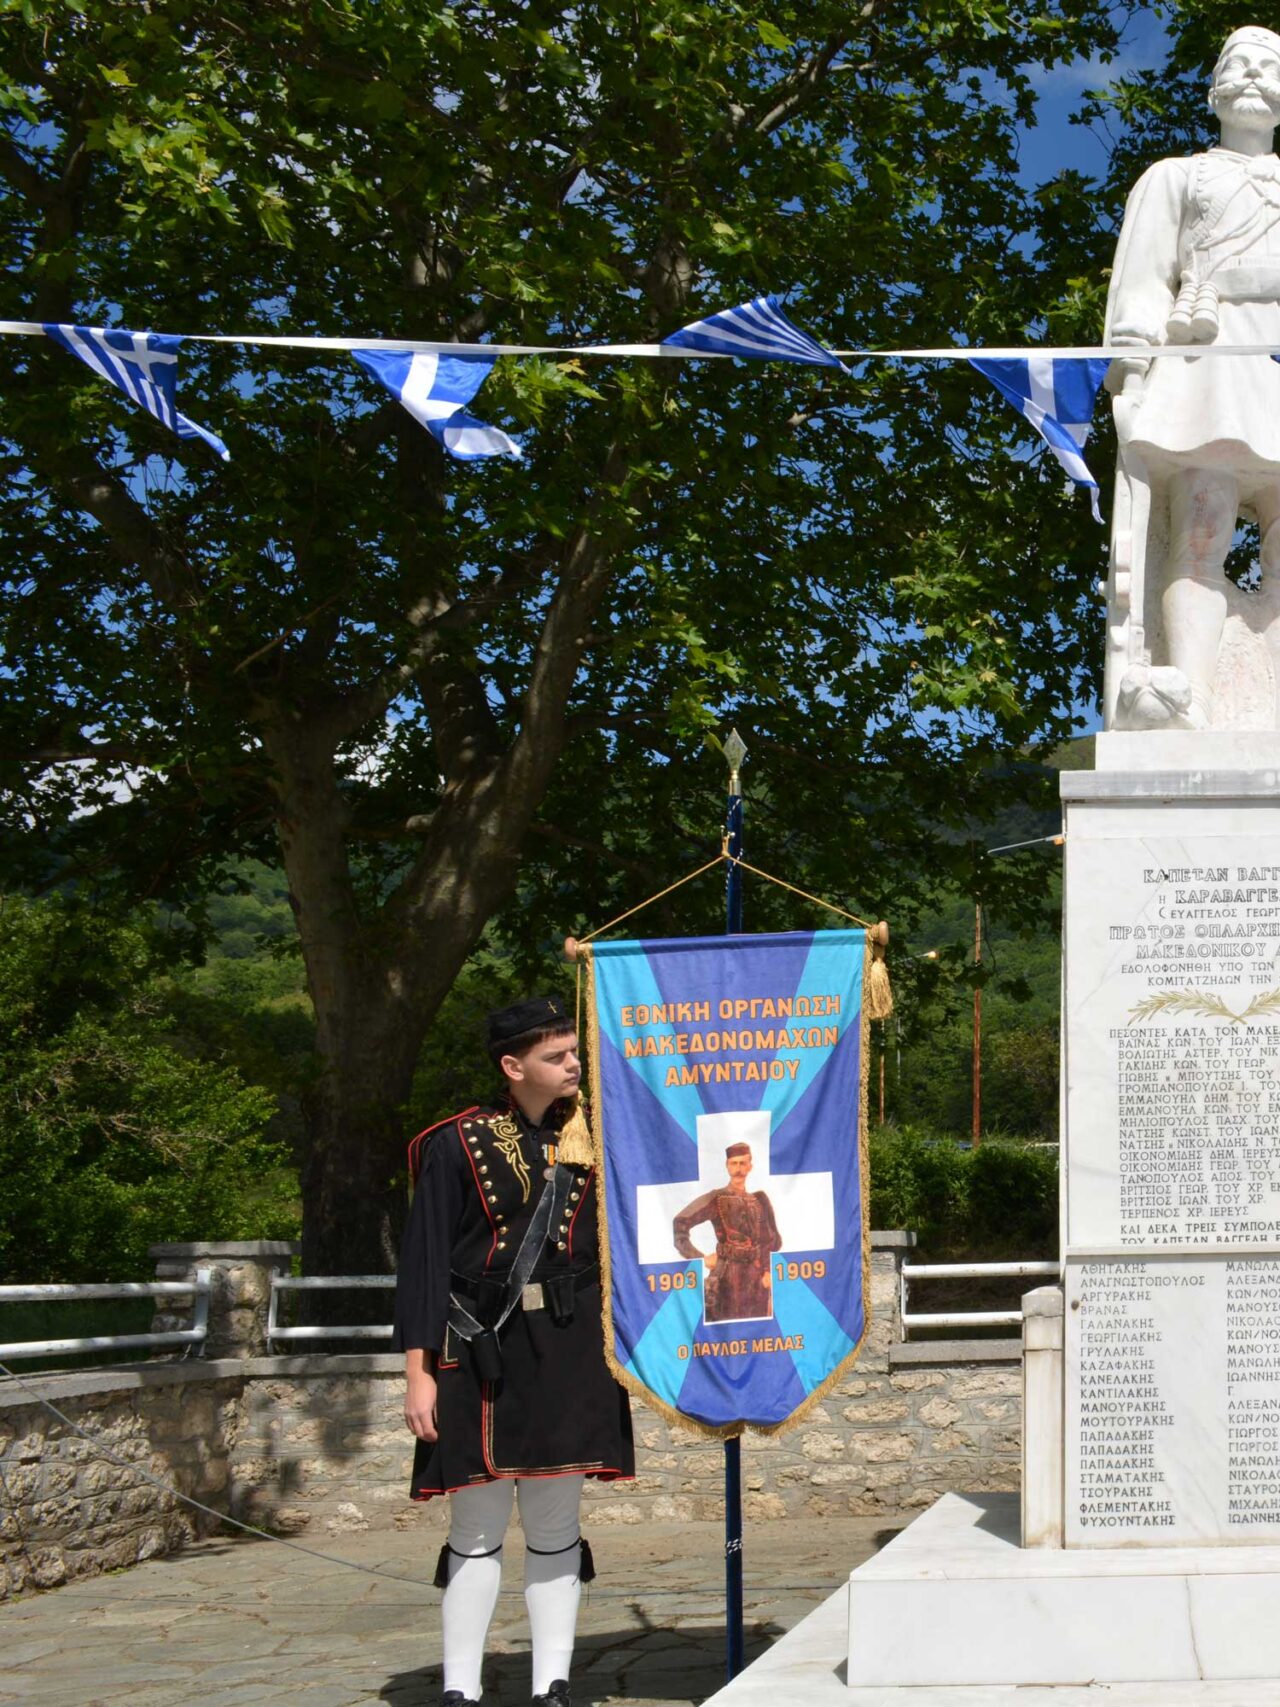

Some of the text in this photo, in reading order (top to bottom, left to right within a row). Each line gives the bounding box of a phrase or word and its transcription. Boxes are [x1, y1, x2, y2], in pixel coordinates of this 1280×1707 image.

[1143, 868, 1229, 883] ΚΑΠΕΤΑΝ
[1109, 925, 1185, 940] ΠΡΩΤΟΣ
[1136, 942, 1266, 959] ΜΑΚΕΔΟΝΙΚΟΥ
[1121, 962, 1211, 974] ΕΔΟΛΟΦΟΝΗΘΗ
[1219, 962, 1244, 972] ΥΠΟ
[1251, 961, 1275, 971] ΤΩΝ
[1147, 975, 1241, 986] ΚΟΜΙΤΑΤΖΗΔΩΝ
[1249, 974, 1272, 984] ΤΗΝ
[620, 995, 841, 1027] ΕΘΝΙΚΗ ΟΡΓΑΝΩΣΗ
[1109, 1028, 1167, 1038] ΠΕΣΟΝΤΕΣ
[1175, 1027, 1206, 1037] ΚΑΤΑ
[1214, 1026, 1239, 1036] ΤΟΝ
[624, 1026, 840, 1058] ΜΑΚΕΔΟΝΟΜΑΧΩΝ
[1199, 1037, 1223, 1047] ΤΟΥ
[1267, 1036, 1280, 1045] ΕΞ
[1228, 1048, 1252, 1057] ΤΟΥ
[1118, 1061, 1167, 1071] ΓΑΚΙΔΗΣ
[1205, 1059, 1229, 1069] ΤΟΥ
[665, 1059, 800, 1087] ΑΜΥΝΤΑΙΟΥ
[1178, 1070, 1242, 1081] ΜΠΟΥΤΣΗΣ
[1249, 1070, 1274, 1079] ΤΟΥ
[1118, 1094, 1196, 1105] ΕΜΜΑΝΟΥΗΛ
[1236, 1093, 1261, 1102] ΤΟΥ
[1118, 1105, 1197, 1116] ΕΜΜΑΝΟΥΗΛ
[1236, 1104, 1260, 1113] ΤΟΥ
[1119, 1117, 1209, 1127] ΜΗΛΙΟΠΟΥΛΟΣ
[1255, 1115, 1279, 1124] ΤΟΥ
[1119, 1128, 1165, 1139] ΝΑΤΣΗΣ
[1218, 1127, 1242, 1136] ΤΟΥ
[1119, 1140, 1165, 1150] ΝΑΤΣΗΣ
[1177, 1138, 1248, 1148] ΝΙΚΟΛΑΙΔΗΣ
[1119, 1151, 1203, 1161] ΟΙΚΟΝΟΜΙΔΗΣ
[1242, 1148, 1280, 1159] ΙΕΡΕΥΣ
[1119, 1162, 1203, 1172] ΟΙΚΟΝΟΜΙΔΗΣ
[1246, 1160, 1271, 1169] ΤΟΥ
[1250, 1171, 1275, 1180] ΤΟΥ
[1215, 1183, 1240, 1193] ΤΟΥ
[1216, 1194, 1240, 1204] ΤΟΥ
[1120, 1208, 1180, 1219] ΤΕΡΠΕΝΟΣ
[1210, 1206, 1249, 1217] ΙΕΡΕΥΣ
[1120, 1224, 1140, 1234] ΚΑΙ
[1148, 1224, 1177, 1234] ΔΕΚΑ
[1185, 1223, 1217, 1233] ΤΡΕΙΣ
[775, 1261, 826, 1280] 1909
[1080, 1264, 1147, 1274] ΑΘΗΤΑΚΗΣ
[647, 1272, 697, 1292] 1903
[1080, 1276, 1205, 1288] ΑΝΑΓΝΩΣΤΟΠΟΥΛΟΣ
[1080, 1291, 1152, 1302] ΑΡΓΥΡΑΚΗΣ
[1080, 1305, 1127, 1316] ΒΡΑΝΑΣ
[1080, 1318, 1154, 1329] ΓΑΛΑΝΑΚΗΣ
[1080, 1332, 1162, 1343] ΓΕΩΡΓΙΛΑΚΗΣ
[677, 1335, 804, 1359] Ο ΠΑΥΛΟΣ ΜΕΛΑΣ
[1080, 1346, 1145, 1357] ΓΡΥΛΑΚΗΣ
[1080, 1360, 1155, 1371] ΚΑΖΑΦΑΚΗΣ
[1080, 1371, 1280, 1385] ΚΑΝΕΛΑΚΗΣ ΙΩΑΝΝΗΣ
[1080, 1388, 1159, 1399] ΚΑΝΤΙΛΑΚΗΣ
[1080, 1401, 1166, 1412] ΜΑΝΟΥΡΑΚΗΣ
[1080, 1416, 1174, 1427] ΜΟΥΤΟΥΡΑΚΗΣ
[1080, 1427, 1279, 1441] ΠΑΠΑΔΑΚΗΣ ΓΙΩΡΓΟΣ
[1080, 1441, 1279, 1455] ΠΑΠΑΔΑΚΗΣ ΓΙΩΡΓΟΣ
[1080, 1458, 1155, 1469] ΠΑΠΑΔΑΚΗΣ
[1080, 1472, 1165, 1483] ΣΤΑΜΑΤΑΚΗΣ
[1080, 1487, 1153, 1498] ΤΣΟΥΡΑΚΗΣ
[1079, 1501, 1171, 1513] ΦΛΕΜΕΝΤΑΚΗΣ
[1080, 1515, 1175, 1527] ΨΥΧΟΥΝΤΑΚΗΣ
